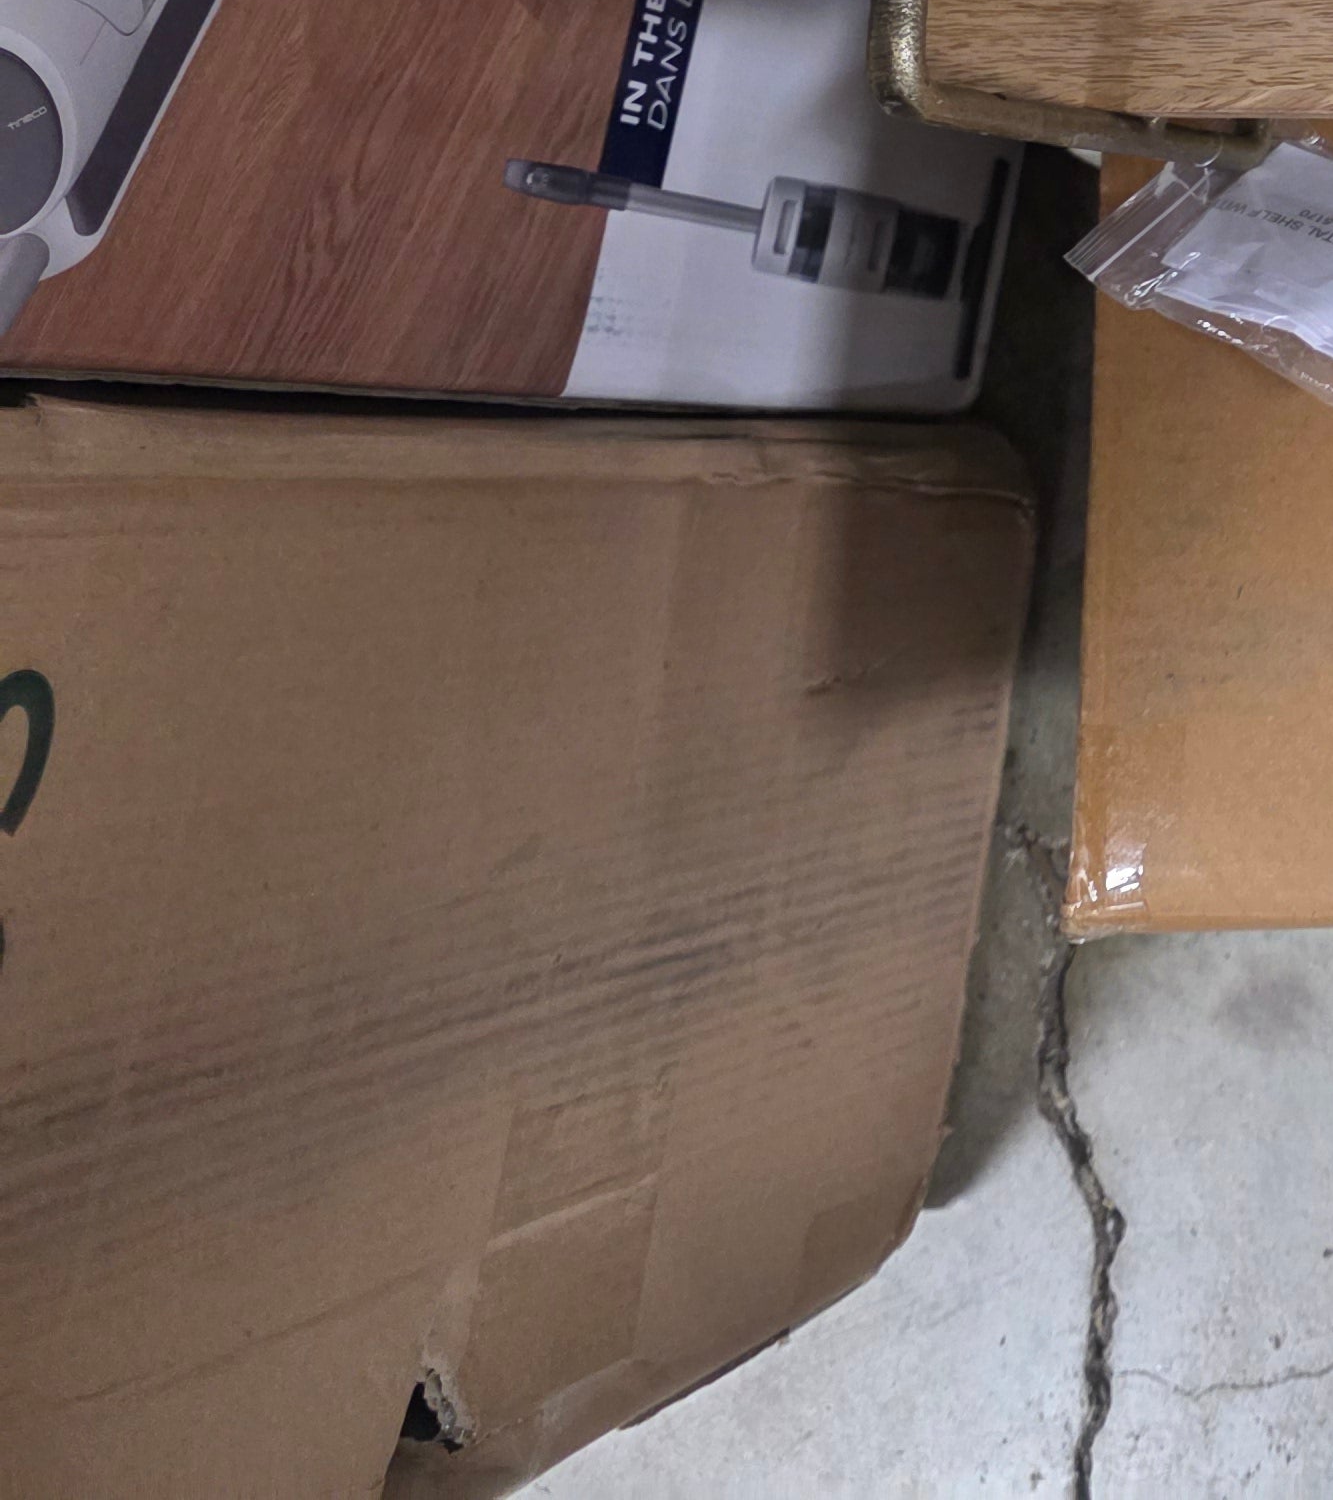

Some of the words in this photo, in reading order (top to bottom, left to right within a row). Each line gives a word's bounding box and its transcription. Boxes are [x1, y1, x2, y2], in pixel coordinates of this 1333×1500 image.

[646, 19, 687, 132] DANS
[619, 81, 646, 126] IN
[1250, 210, 1304, 232] SHELF
